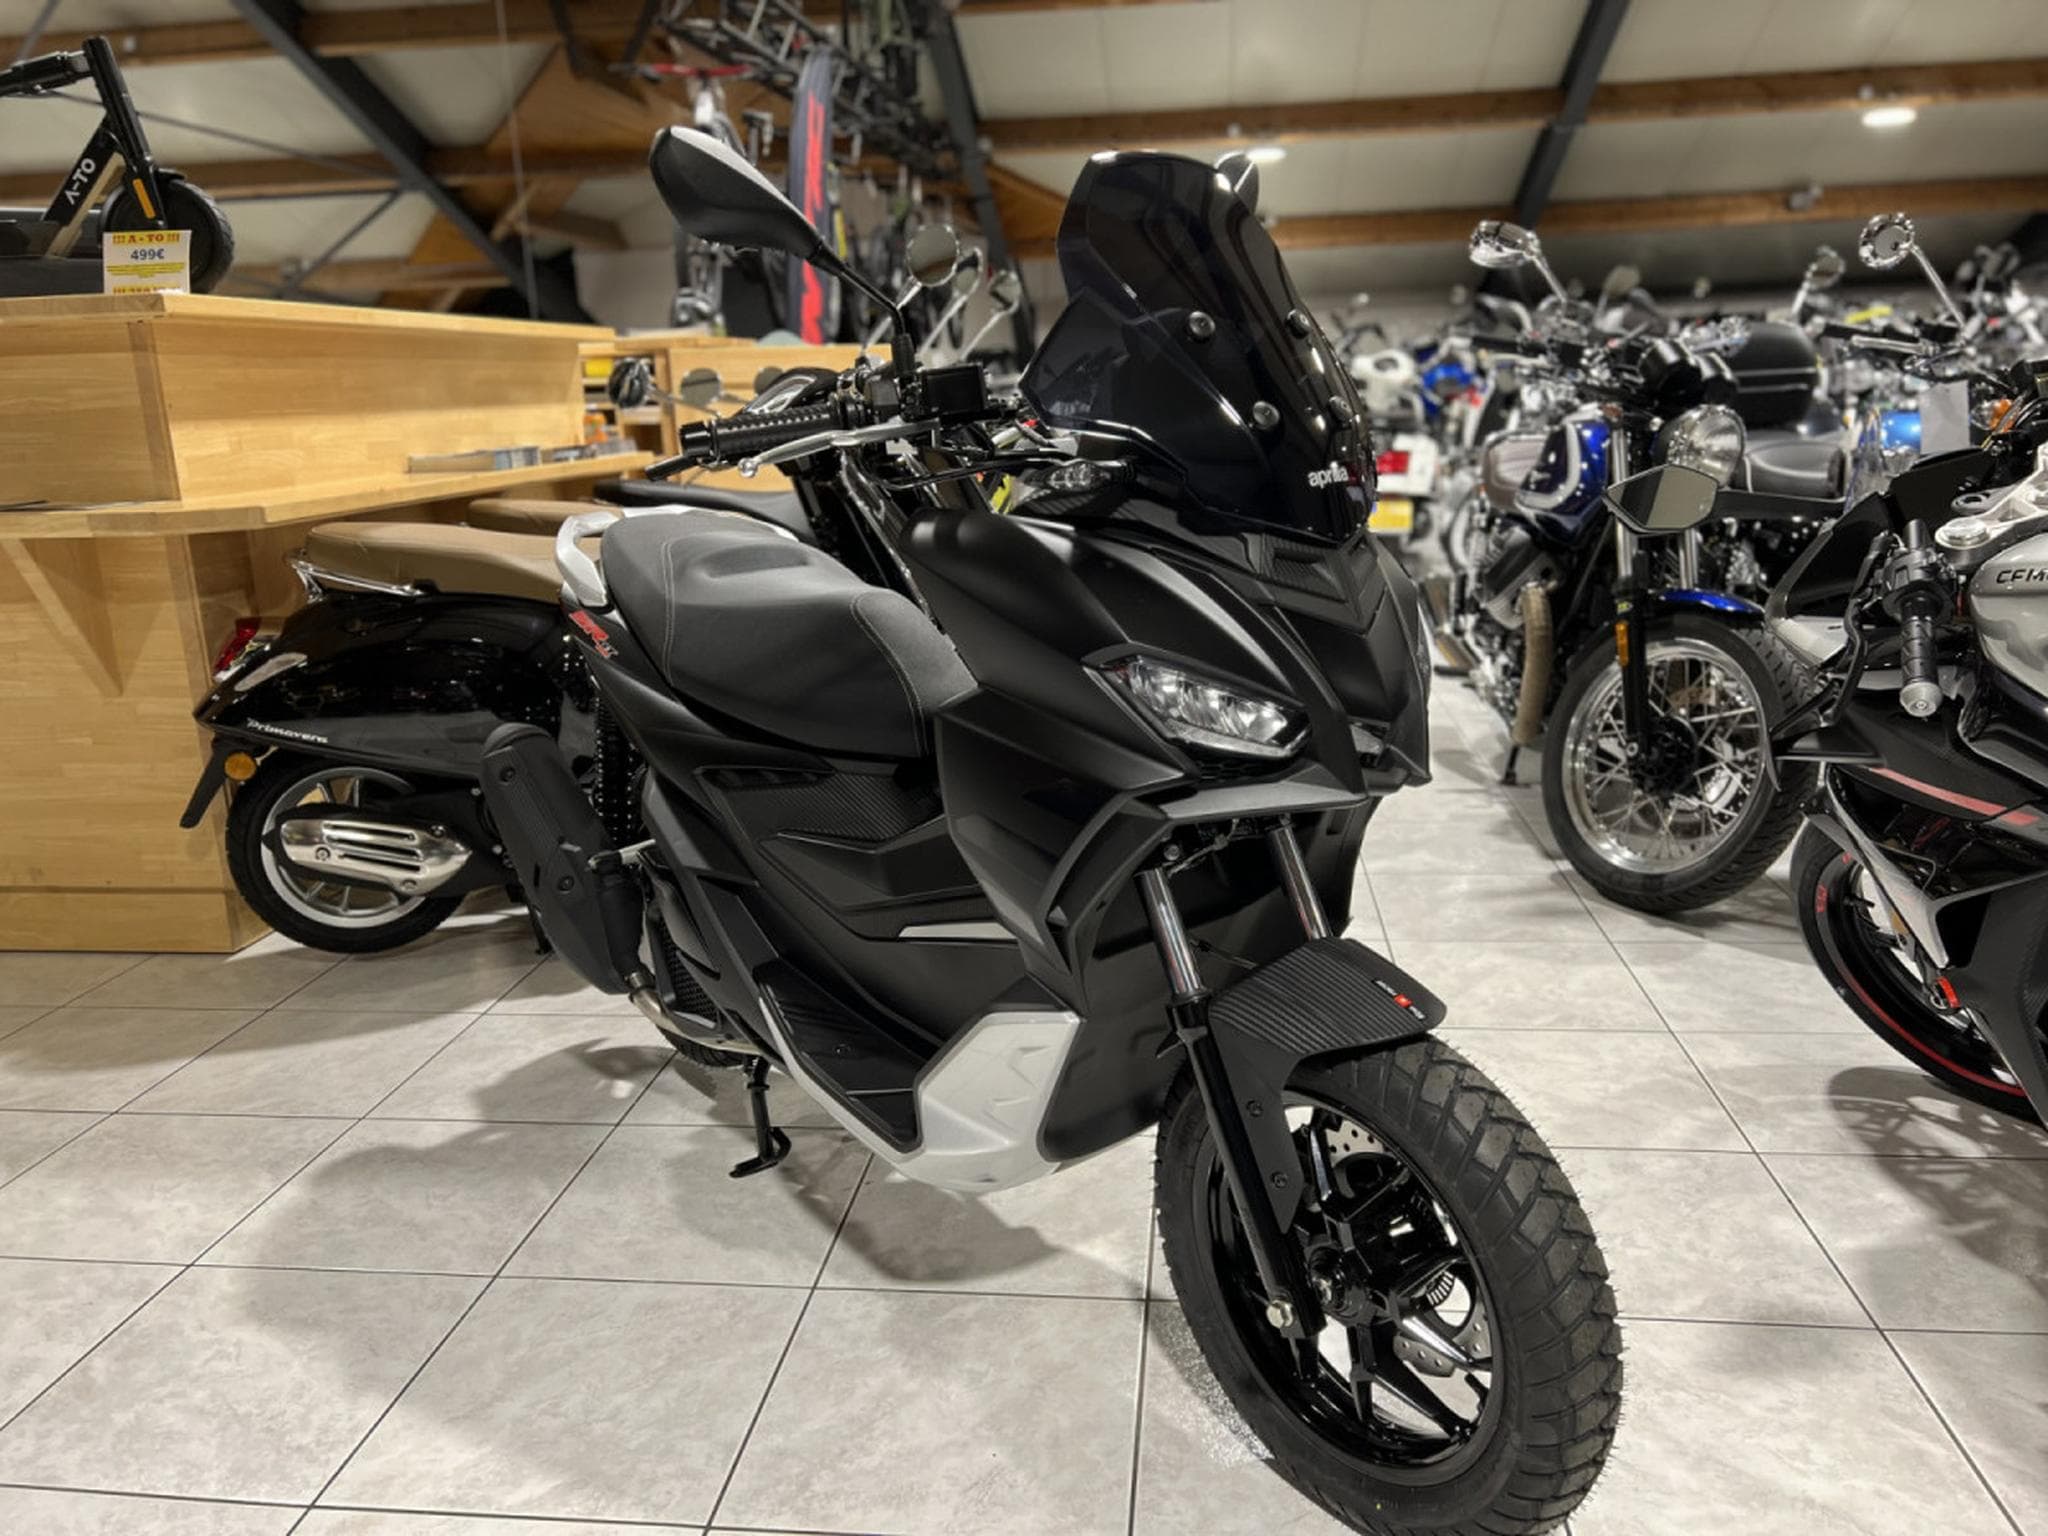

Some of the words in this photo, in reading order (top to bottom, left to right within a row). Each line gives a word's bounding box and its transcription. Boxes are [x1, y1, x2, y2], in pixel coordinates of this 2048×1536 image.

[65, 158, 96, 205] A-TO
[130, 249, 165, 260] 499€
[1996, 568, 2048, 584] CFM
